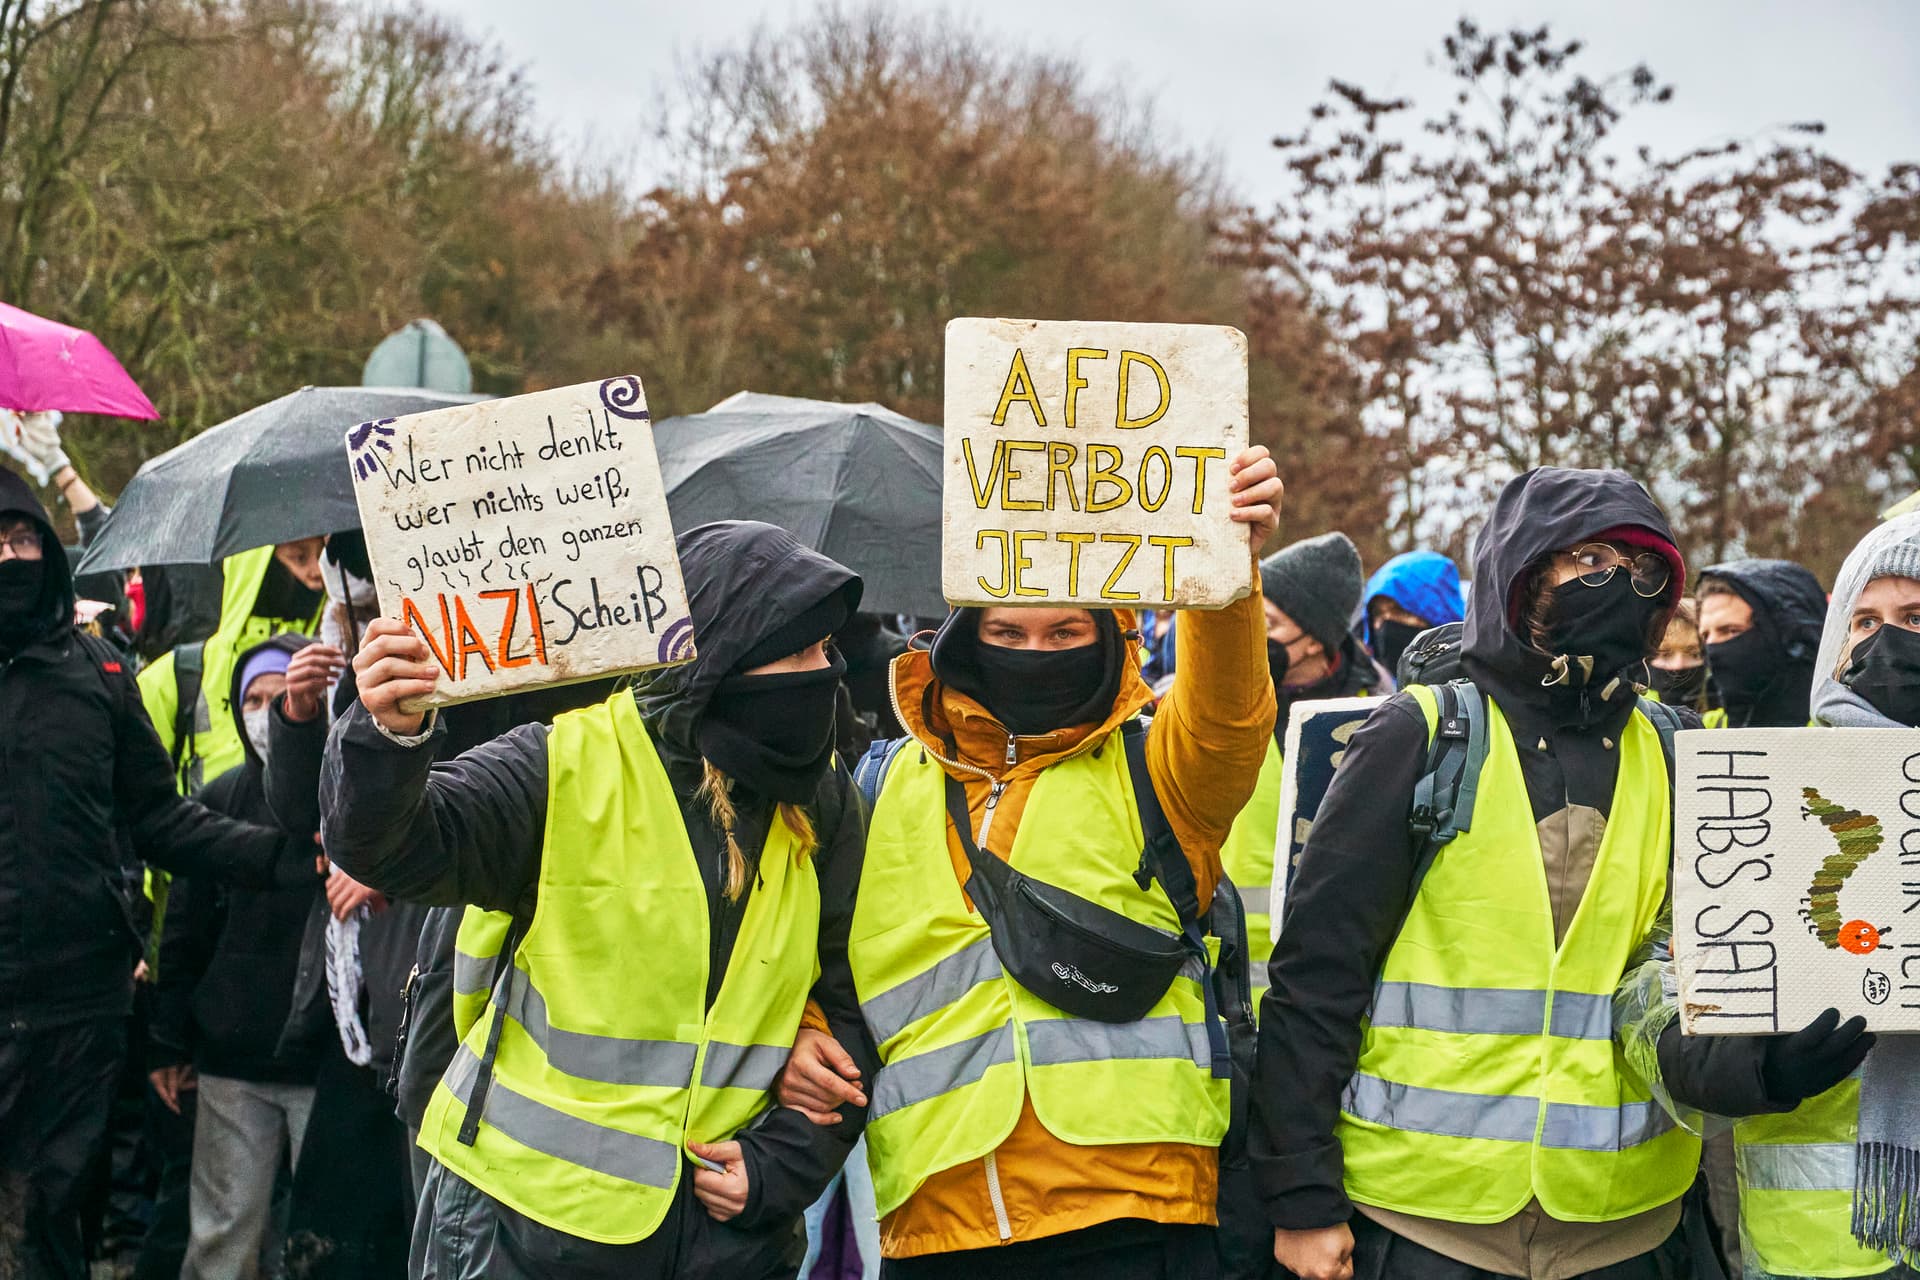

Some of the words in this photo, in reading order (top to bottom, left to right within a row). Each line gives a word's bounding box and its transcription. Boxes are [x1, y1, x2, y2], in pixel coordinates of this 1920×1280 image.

[991, 347, 1171, 429] AFD
[369, 434, 453, 490] Wer
[466, 440, 525, 474] nicht
[538, 409, 623, 461] denkt,
[962, 437, 1226, 514] VERBOT
[394, 503, 457, 531] wer
[473, 483, 544, 519] nichts
[556, 467, 629, 508] weiß,
[407, 530, 484, 592] glaubt
[500, 526, 546, 559] den
[562, 519, 642, 562] ganzen
[976, 529, 1194, 601] JETZT
[1695, 750, 1776, 889] HAB'S
[1695, 905, 1779, 1032] SATT
